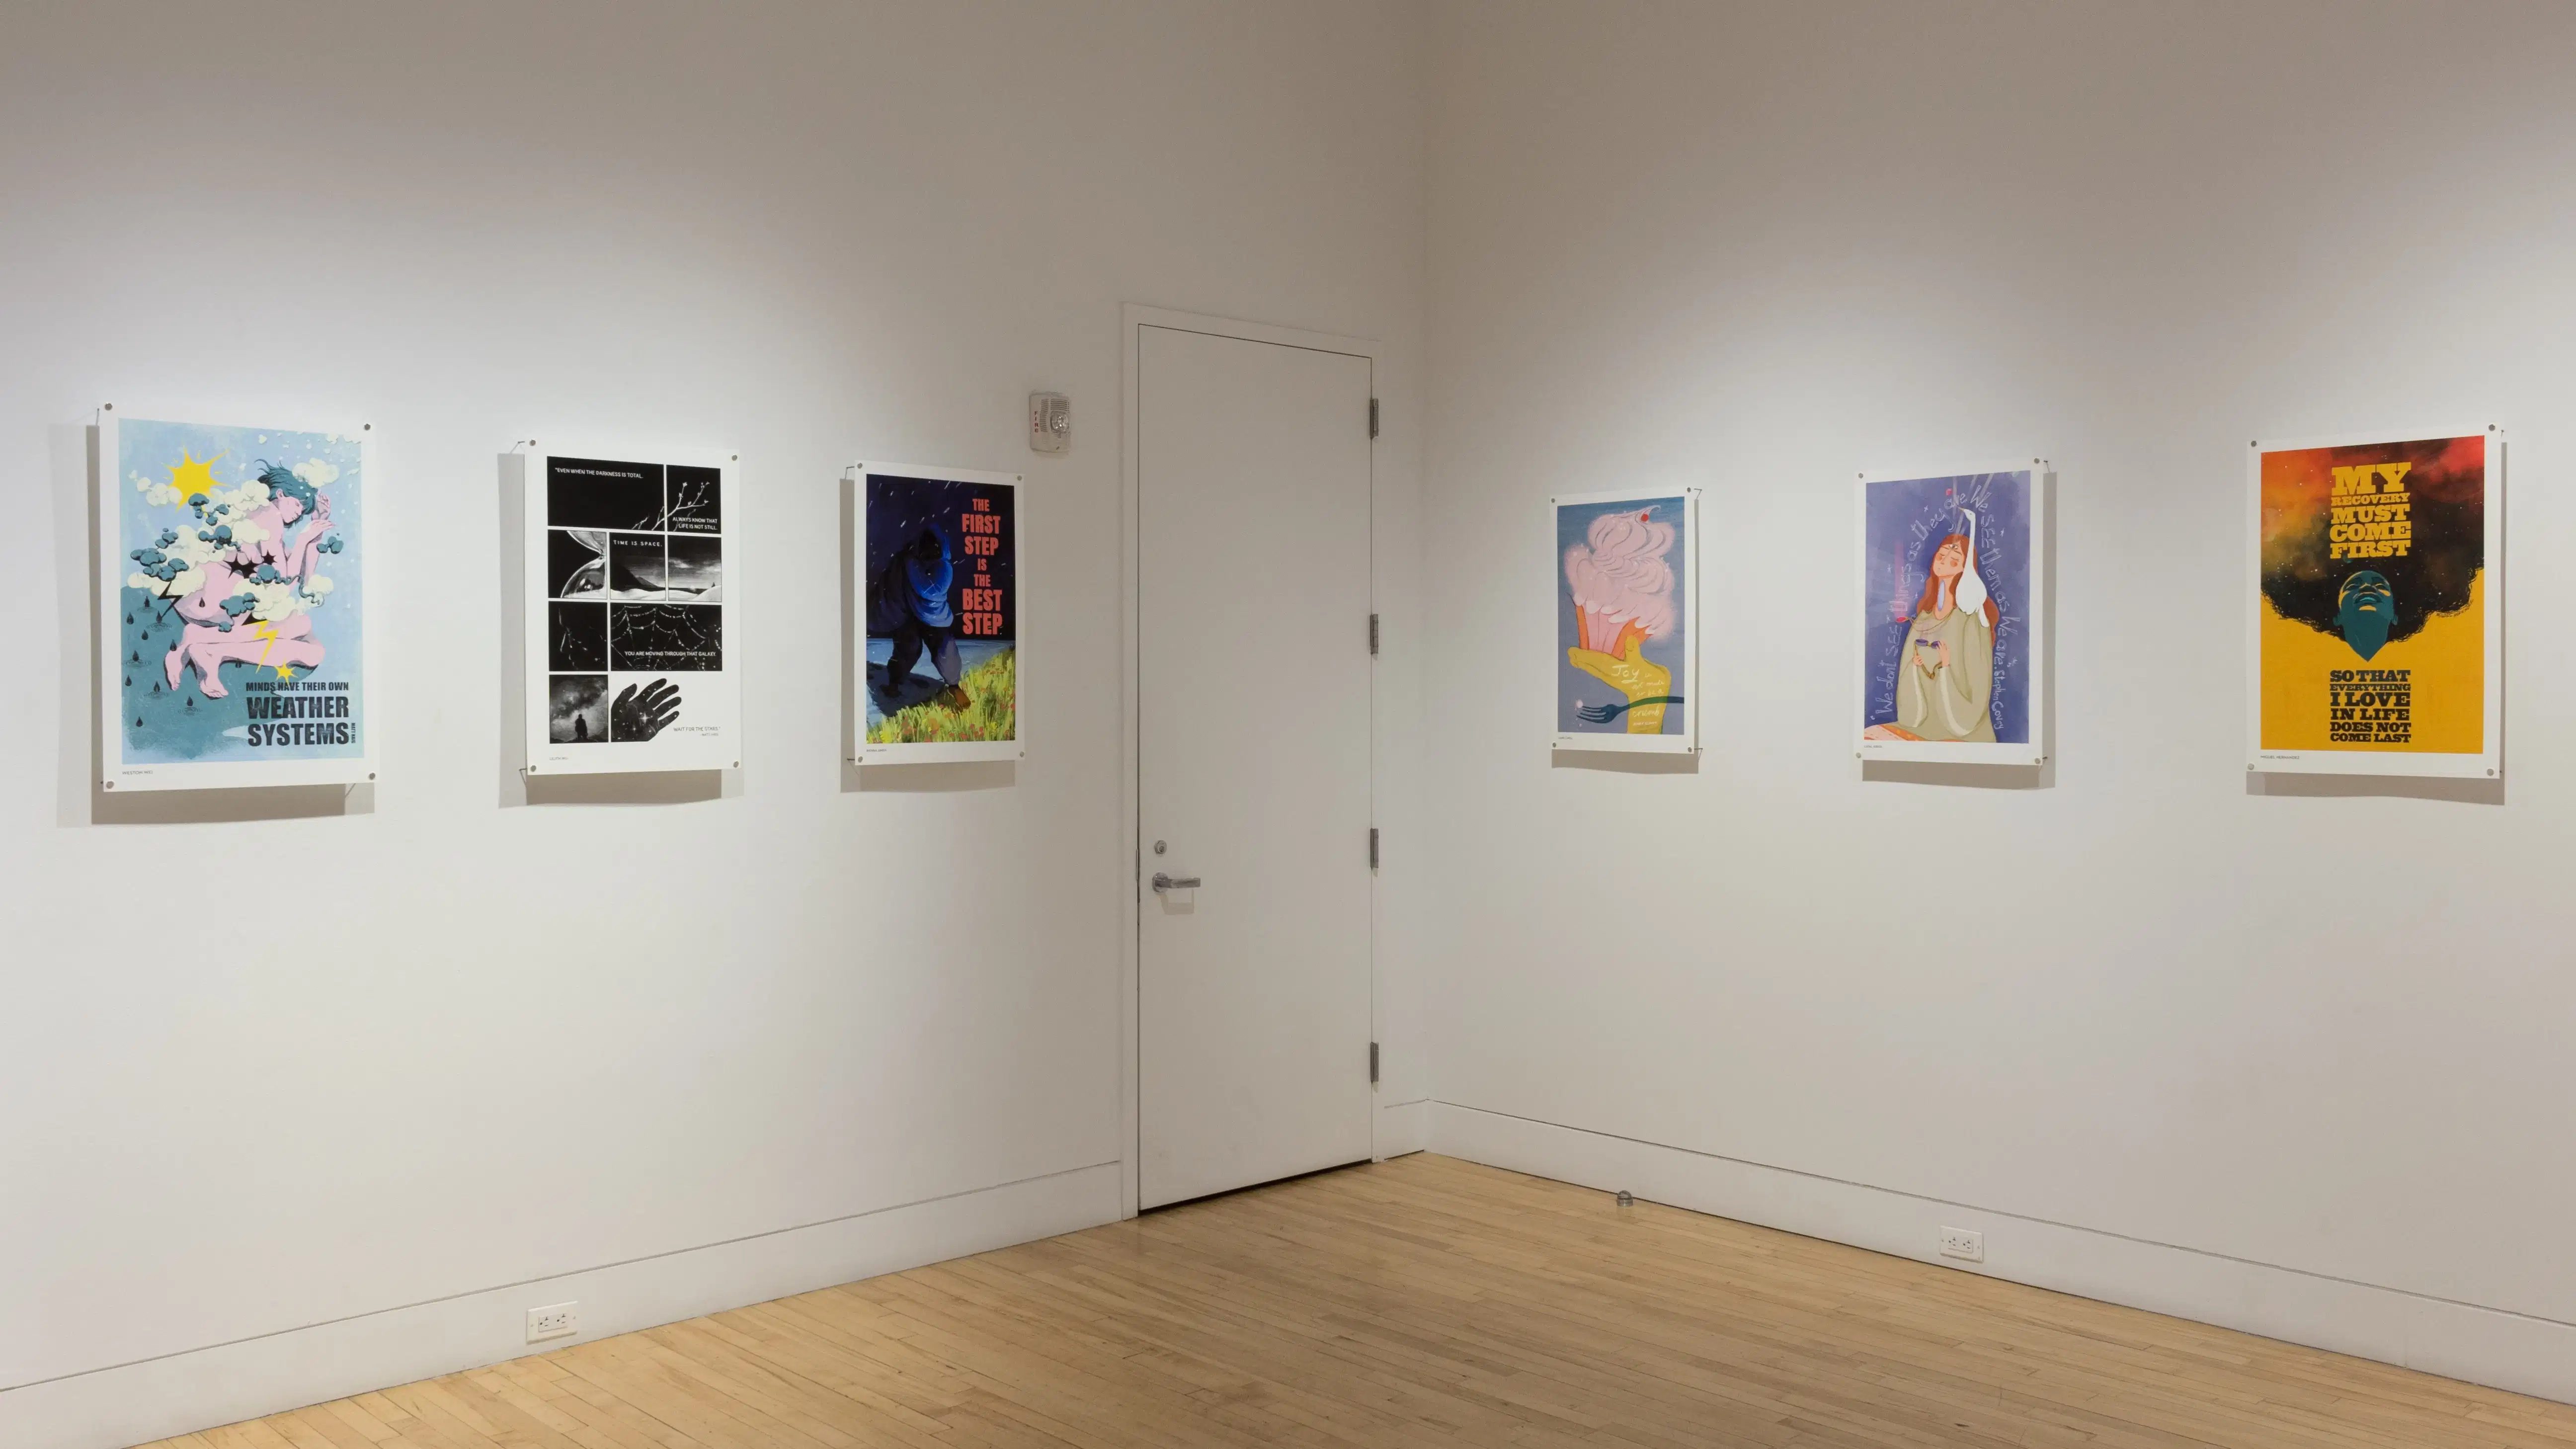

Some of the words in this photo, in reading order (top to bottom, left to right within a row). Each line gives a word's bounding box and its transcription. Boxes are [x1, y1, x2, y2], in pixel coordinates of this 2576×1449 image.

[2331, 462, 2412, 496] MY
[972, 498, 990, 512] THE
[1944, 493, 1968, 510] are
[1970, 485, 1992, 512] We
[2331, 492, 2411, 506] RECOVERY
[962, 513, 1001, 534] FIRST
[2331, 503, 2410, 524] MUST
[1911, 508, 1956, 541] they
[1980, 514, 1996, 548] SEE
[2330, 521, 2411, 542] COME
[965, 536, 999, 556] STEP
[1907, 541, 1922, 562] as
[2330, 540, 2411, 559] FIRST
[977, 558, 987, 571] IS
[1980, 548, 2002, 591] them
[973, 574, 991, 587] THE
[1888, 563, 1926, 612] things
[962, 588, 1002, 611] BEST
[1995, 591, 2010, 612] as
[963, 612, 1002, 635] STEP
[1998, 616, 2021, 636] We
[1886, 625, 1903, 657] SEE
[2330, 670, 2355, 682] SO
[2356, 670, 2411, 682] THAT
[246, 682, 276, 692] MINDS
[278, 682, 300, 691] HAVE
[301, 682, 326, 691] THEIR
[328, 682, 349, 691] OWN
[246, 696, 349, 719] WEATHER
[2330, 692, 2340, 707] I
[2344, 692, 2411, 707] LOVE
[2331, 708, 2355, 720] IN
[2360, 709, 2410, 721] LIFE
[248, 722, 349, 746] SYSTEMS
[2330, 722, 2373, 732] DOES
[2376, 722, 2411, 732] NOT
[2330, 732, 2372, 742] COME
[2374, 733, 2411, 743] LAST
